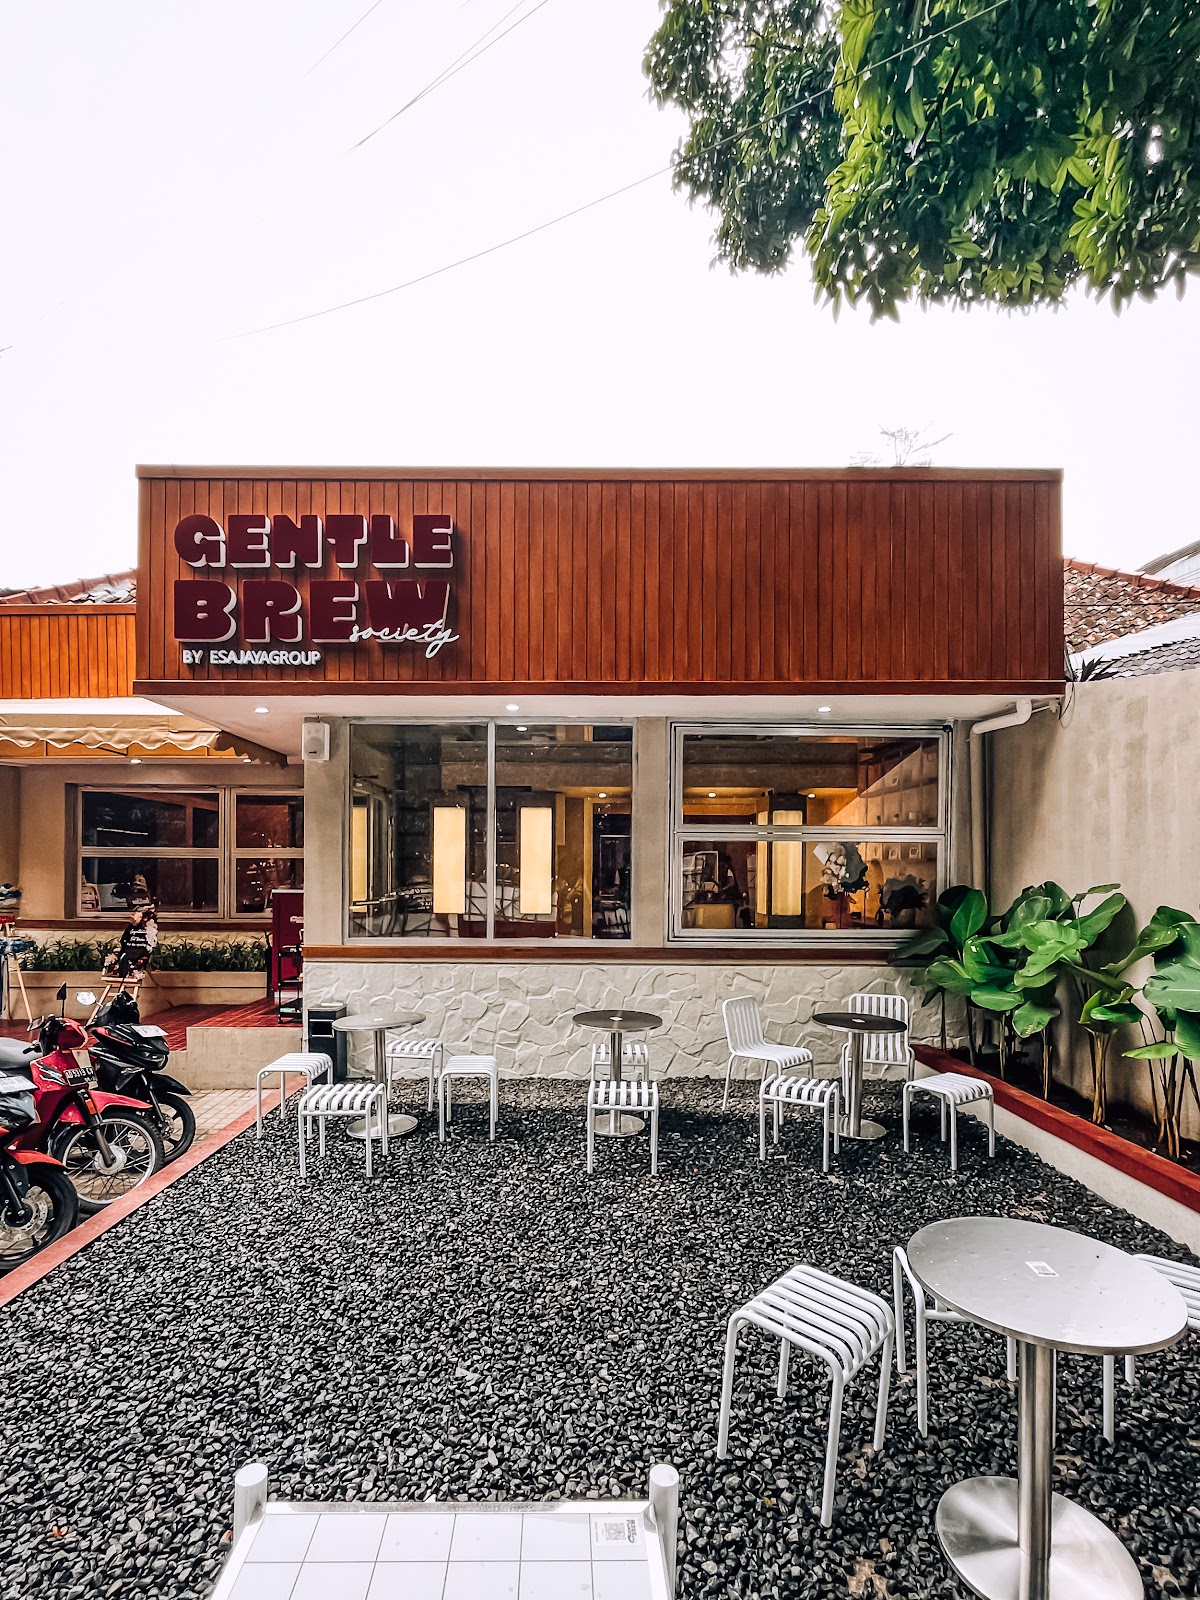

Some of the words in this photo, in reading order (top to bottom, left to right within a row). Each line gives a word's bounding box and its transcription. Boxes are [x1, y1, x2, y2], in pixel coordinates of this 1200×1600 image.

[174, 514, 454, 569] GENTLE
[174, 579, 451, 643] BREW
[182, 649, 203, 665] BY
[209, 649, 321, 666] ESAJAYAGROUP
[349, 618, 460, 659] society
